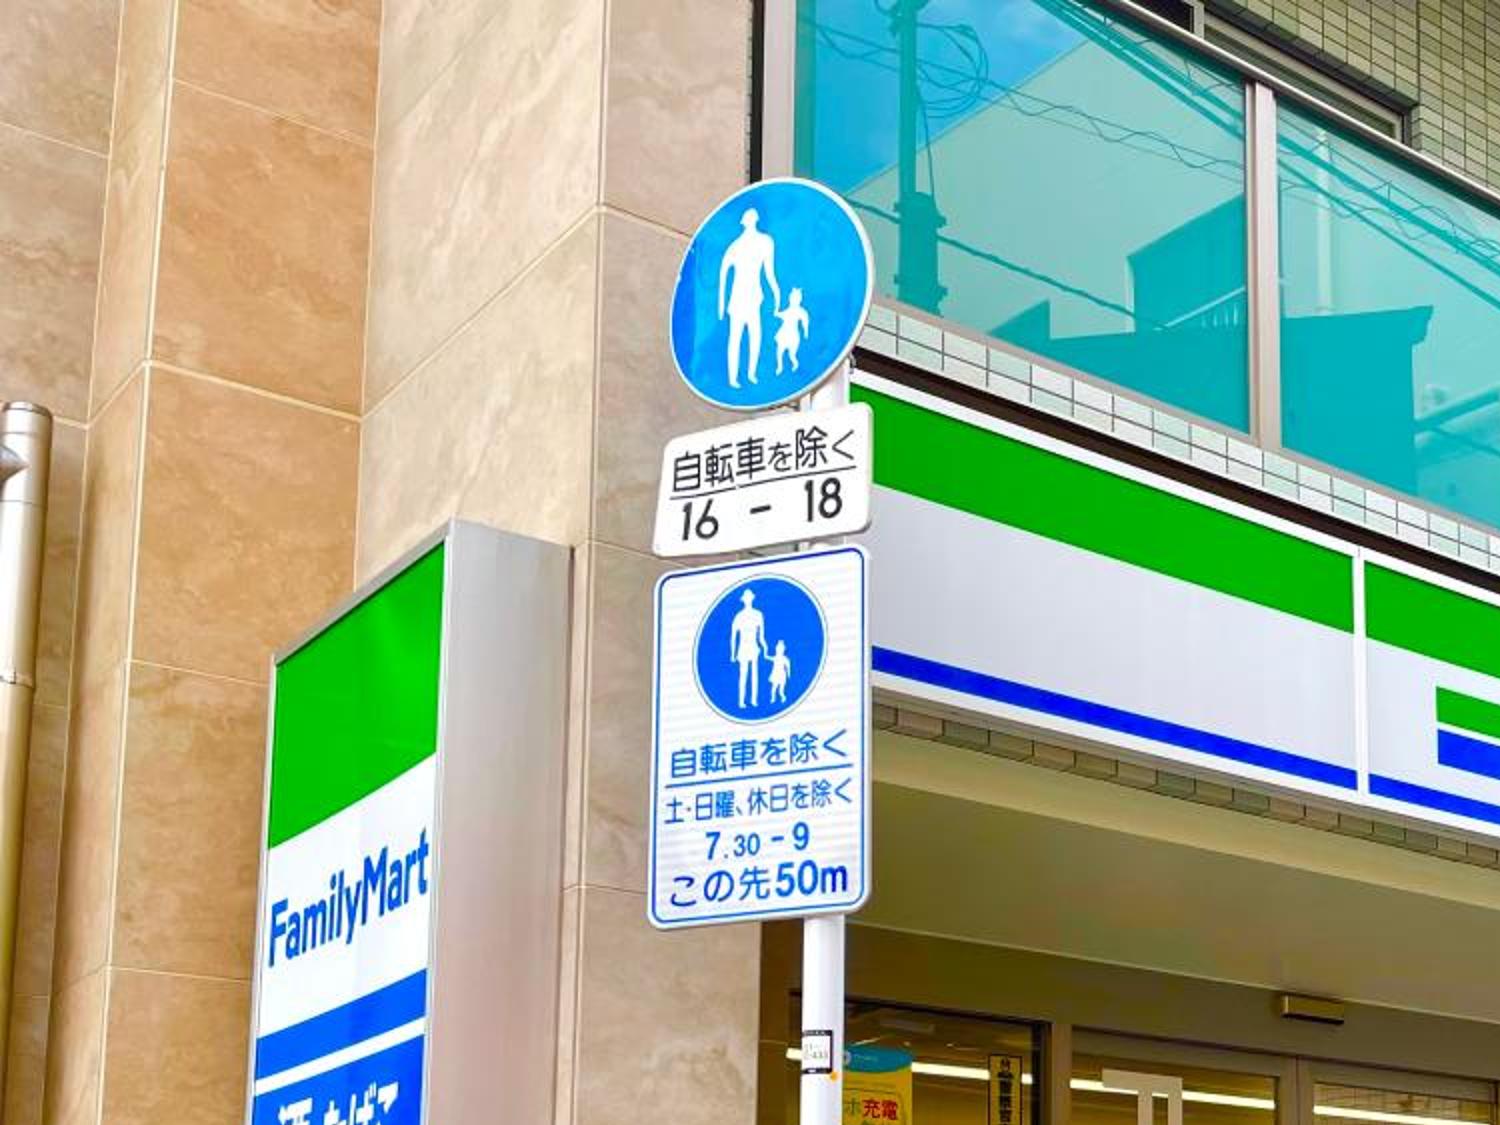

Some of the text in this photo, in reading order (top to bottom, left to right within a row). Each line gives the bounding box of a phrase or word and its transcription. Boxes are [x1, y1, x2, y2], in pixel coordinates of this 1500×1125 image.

[672, 427, 856, 493] 自転車を除く
[681, 498, 720, 541] 16
[803, 476, 844, 523] 18
[669, 729, 850, 779] 自転車を除く
[792, 822, 810, 849] 9
[268, 827, 430, 967] FamilyMart
[668, 861, 849, 908] この先50m
